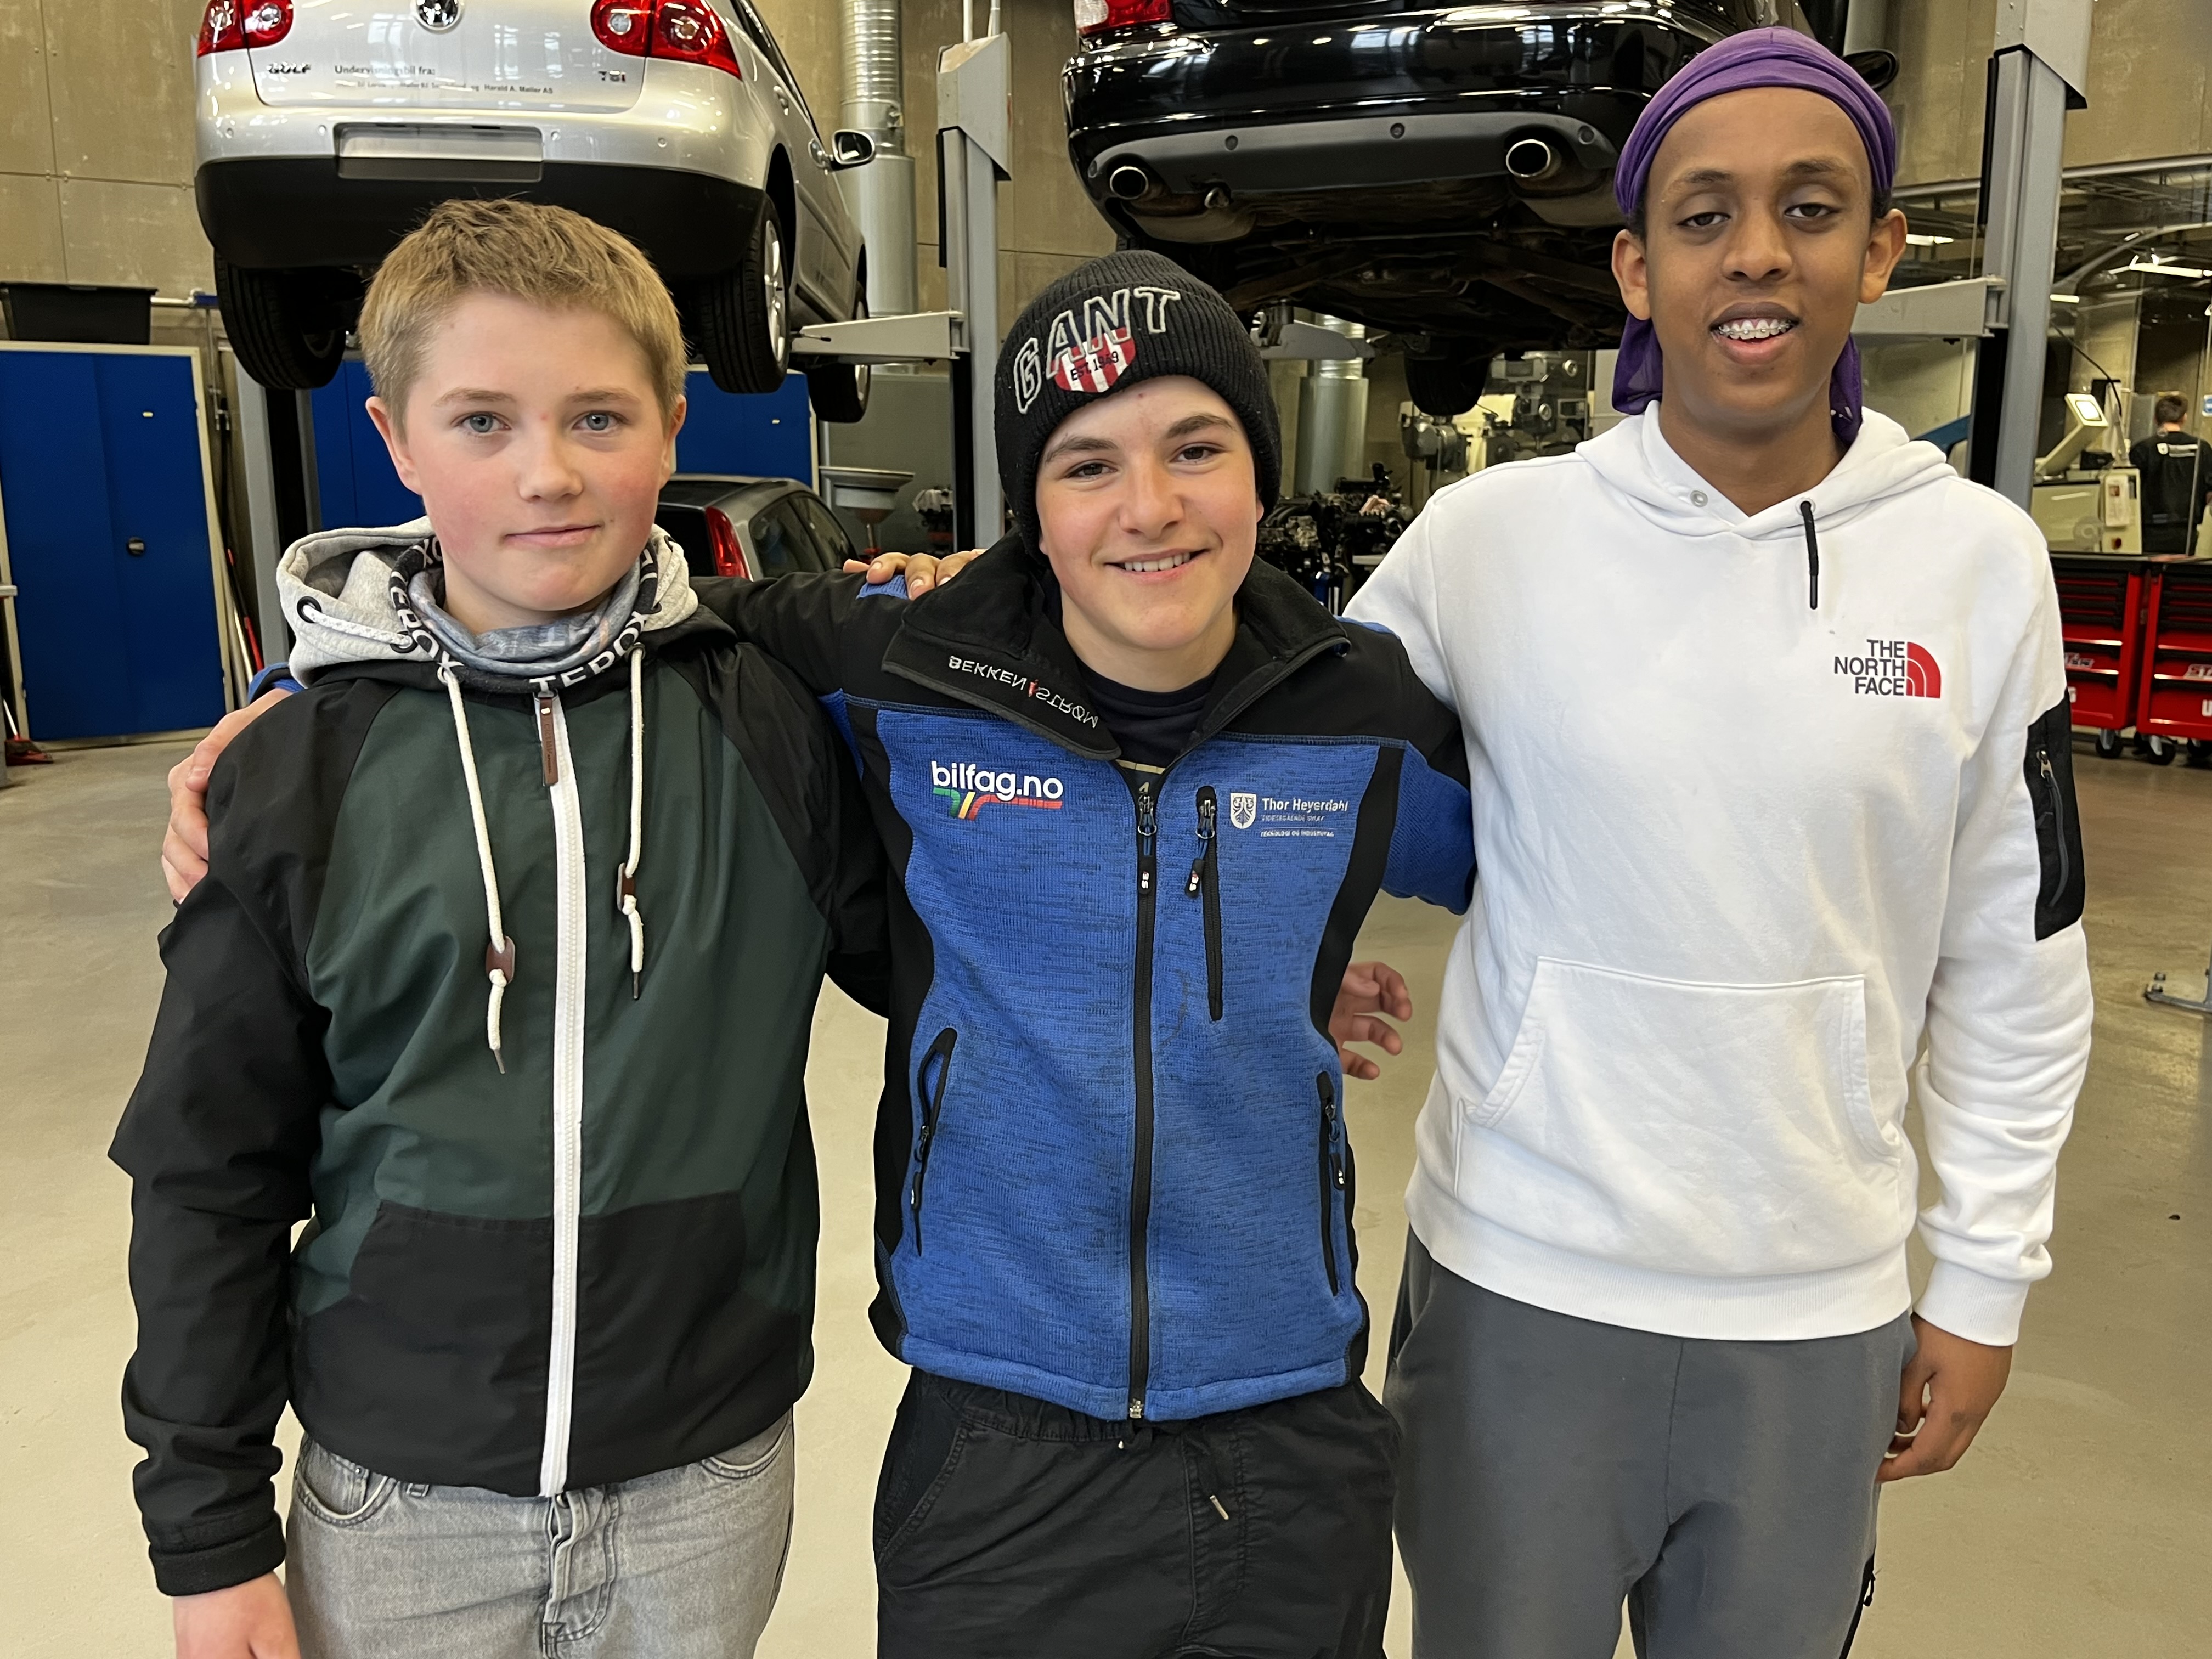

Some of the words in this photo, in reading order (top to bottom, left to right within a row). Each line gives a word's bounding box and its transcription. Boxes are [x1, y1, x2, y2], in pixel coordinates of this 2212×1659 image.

[1013, 286, 1181, 415] GANT
[1866, 639, 1905, 659] THE
[1833, 656, 1905, 677] NORTH
[1854, 676, 1905, 696] FACE
[931, 760, 1064, 802] bilfag.no
[1262, 797, 1290, 811] Thor
[1293, 798, 1349, 813] Heyerdahl
